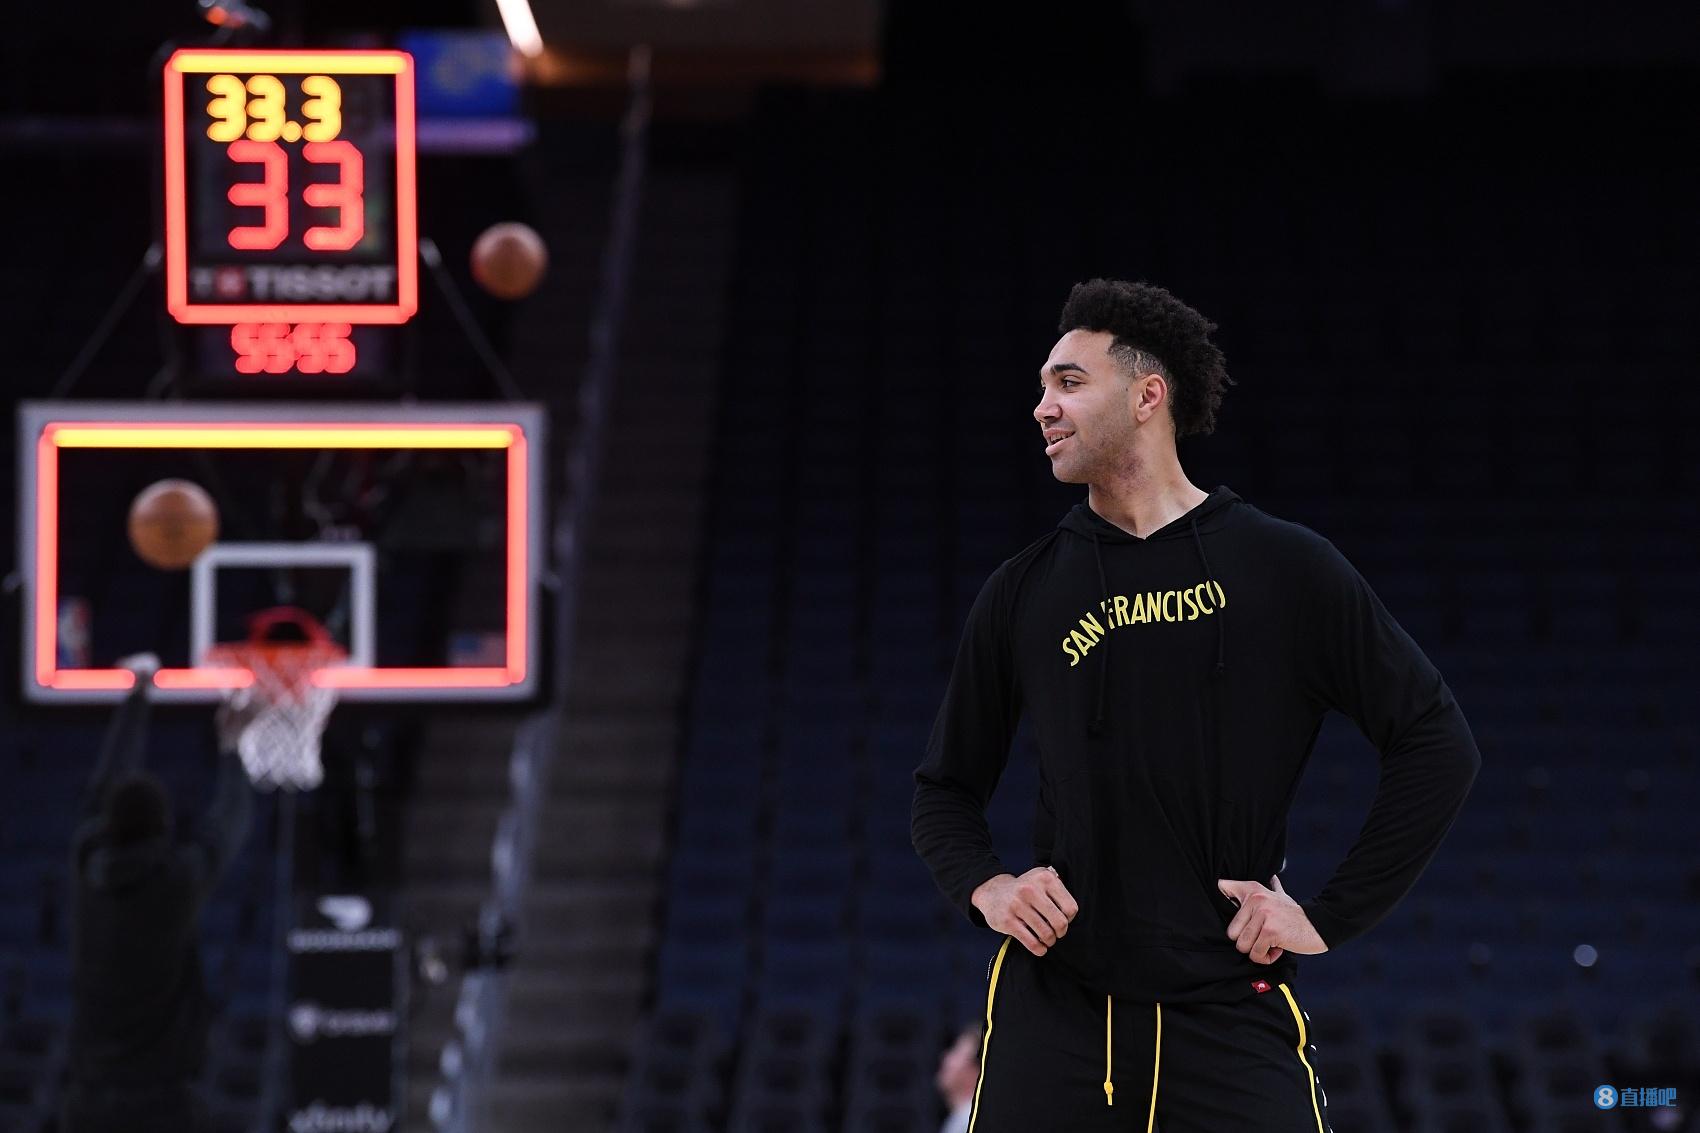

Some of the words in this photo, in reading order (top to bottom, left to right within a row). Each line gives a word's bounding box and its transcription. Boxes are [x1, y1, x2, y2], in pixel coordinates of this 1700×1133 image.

[206, 75, 341, 142] 33.3
[227, 140, 363, 250] 33
[250, 265, 395, 300] TISSOT
[1062, 612, 1105, 667] SAN
